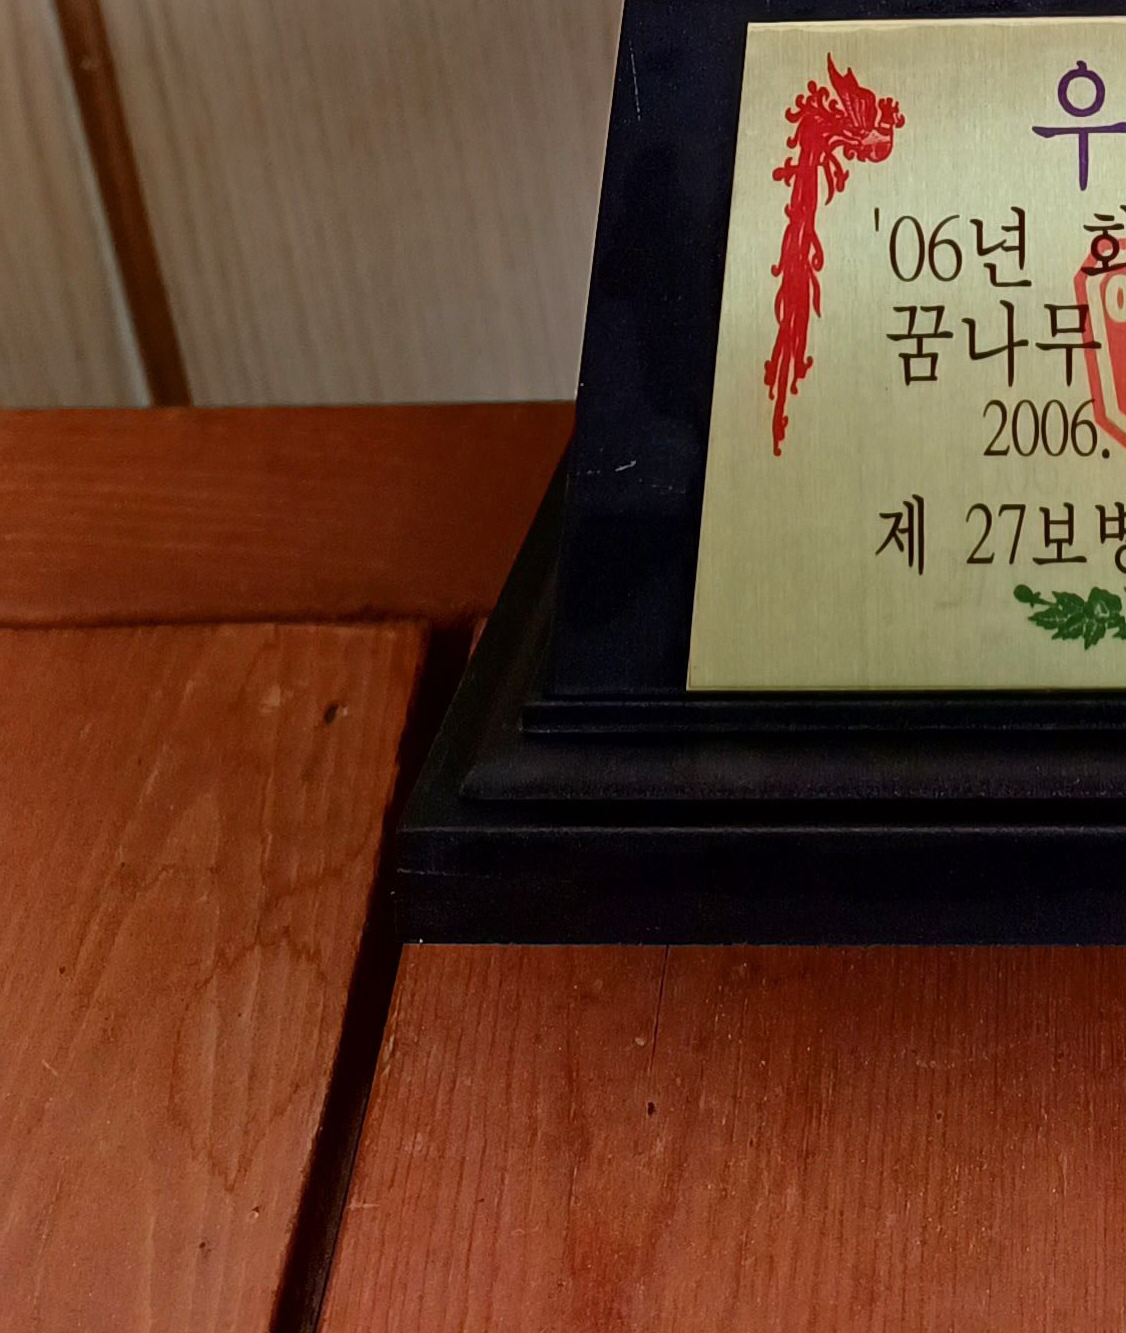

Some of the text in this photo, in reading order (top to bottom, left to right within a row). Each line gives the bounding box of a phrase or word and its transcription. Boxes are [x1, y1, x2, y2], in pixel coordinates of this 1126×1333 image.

[885, 299, 1102, 388] 꿈나무
[982, 399, 1111, 459] 2006.
[874, 493, 925, 576] 제
